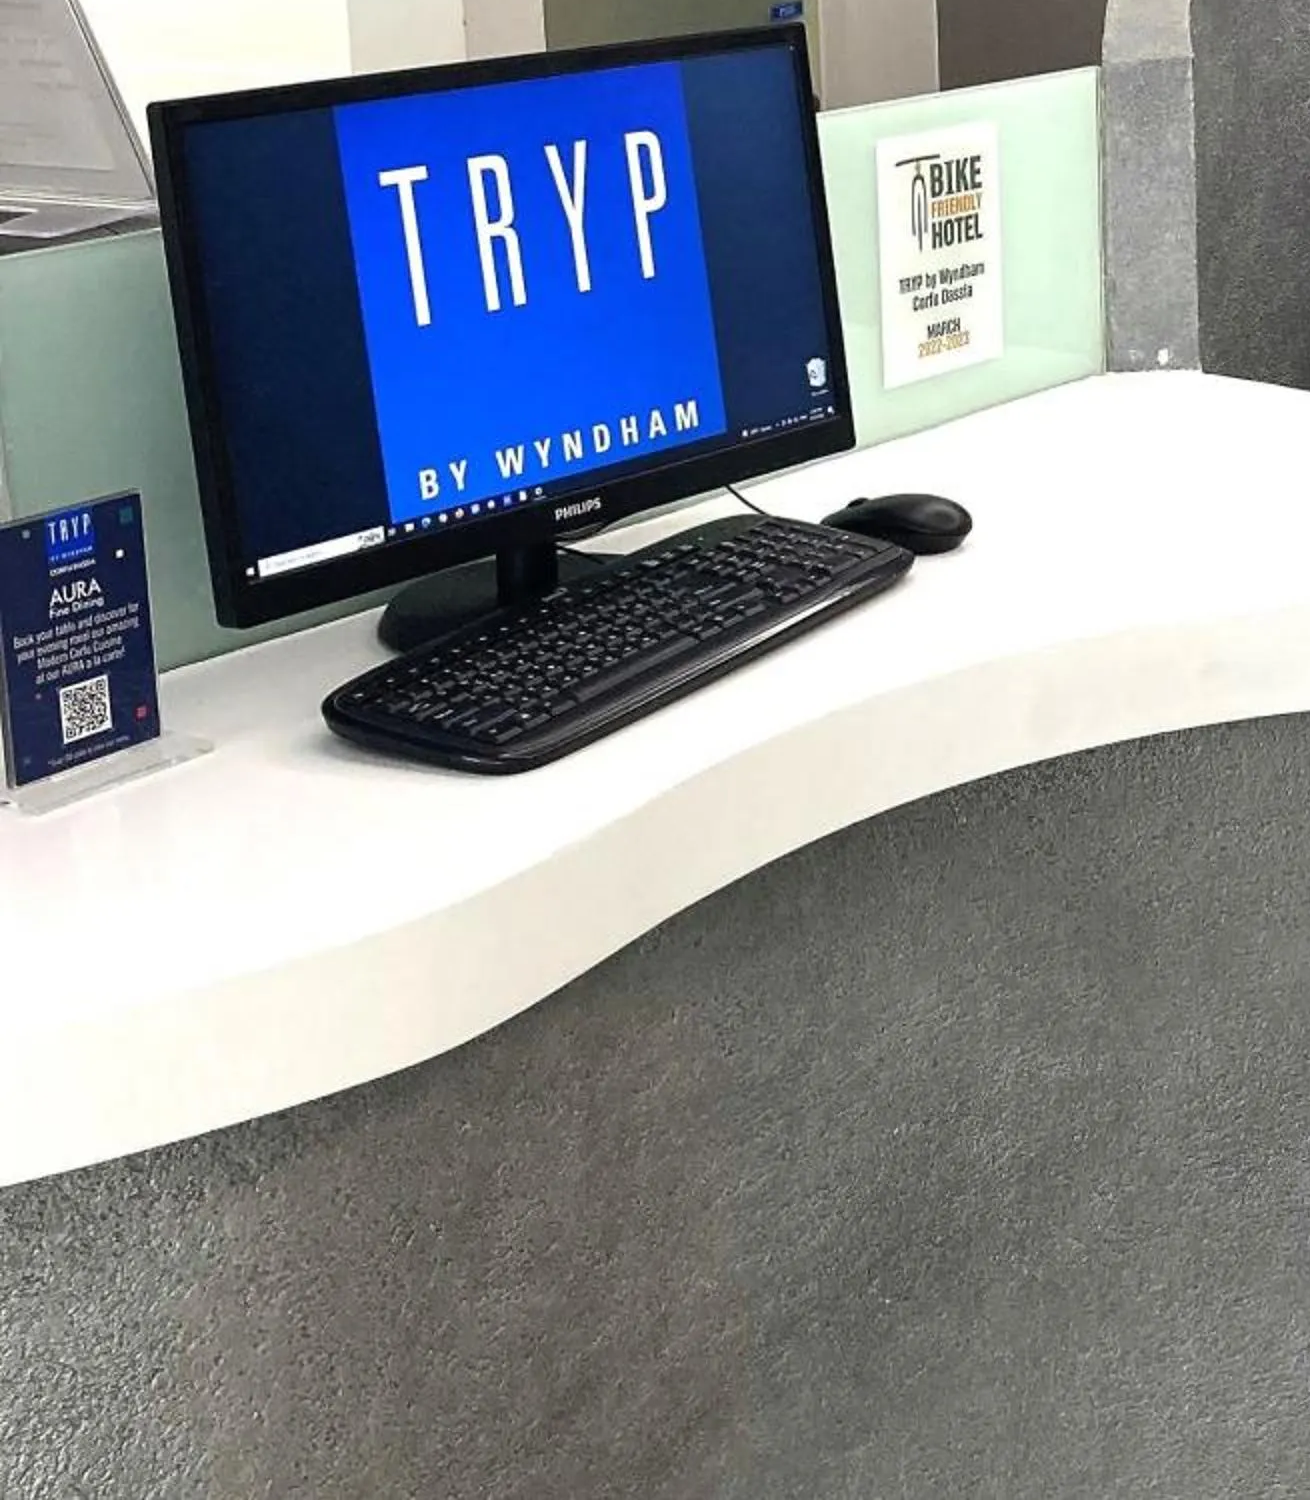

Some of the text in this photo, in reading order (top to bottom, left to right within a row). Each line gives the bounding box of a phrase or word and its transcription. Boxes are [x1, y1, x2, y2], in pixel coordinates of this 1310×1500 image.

[930, 155, 983, 199] BIKE
[931, 192, 983, 219] FRIENDLY
[379, 130, 668, 327] TRYP
[931, 212, 983, 250] HOTEL
[925, 273, 936, 290] by
[938, 262, 985, 286] Wyndham
[927, 317, 961, 339] MARCH
[419, 400, 700, 500] BY WYNDHAM
[554, 498, 602, 523] PHILIPS
[48, 513, 91, 545] TRYP
[50, 578, 101, 605] AURA
